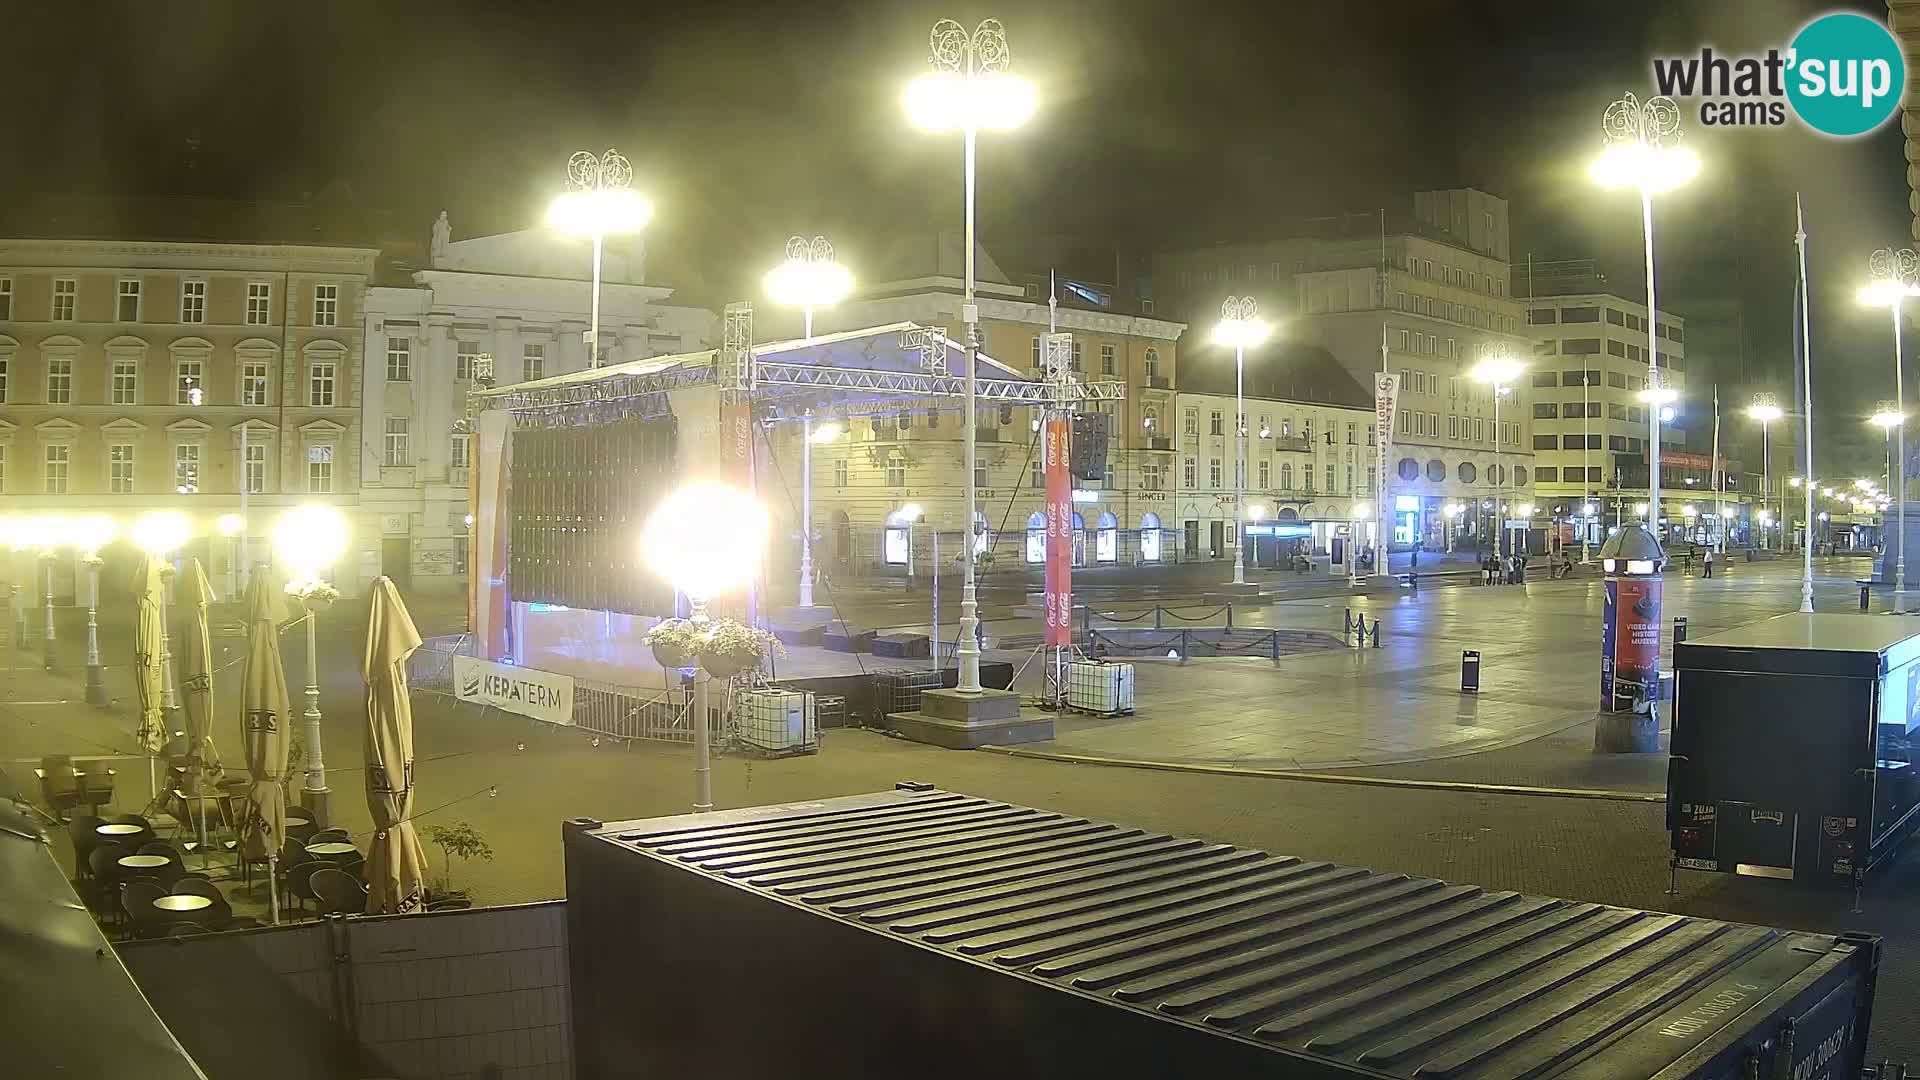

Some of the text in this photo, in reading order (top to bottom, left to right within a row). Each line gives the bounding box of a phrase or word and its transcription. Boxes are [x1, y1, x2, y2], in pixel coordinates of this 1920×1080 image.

[1048, 431, 1057, 466] Coca-Cola
[1048, 502, 1057, 537] Coca-Cola
[1060, 502, 1068, 537] Coca-Cola
[1048, 592, 1057, 627] Coca-Cola
[1060, 592, 1068, 627] Coca-Cola
[484, 675, 561, 710] KERATERM
[1691, 991, 1747, 1018] 300629
